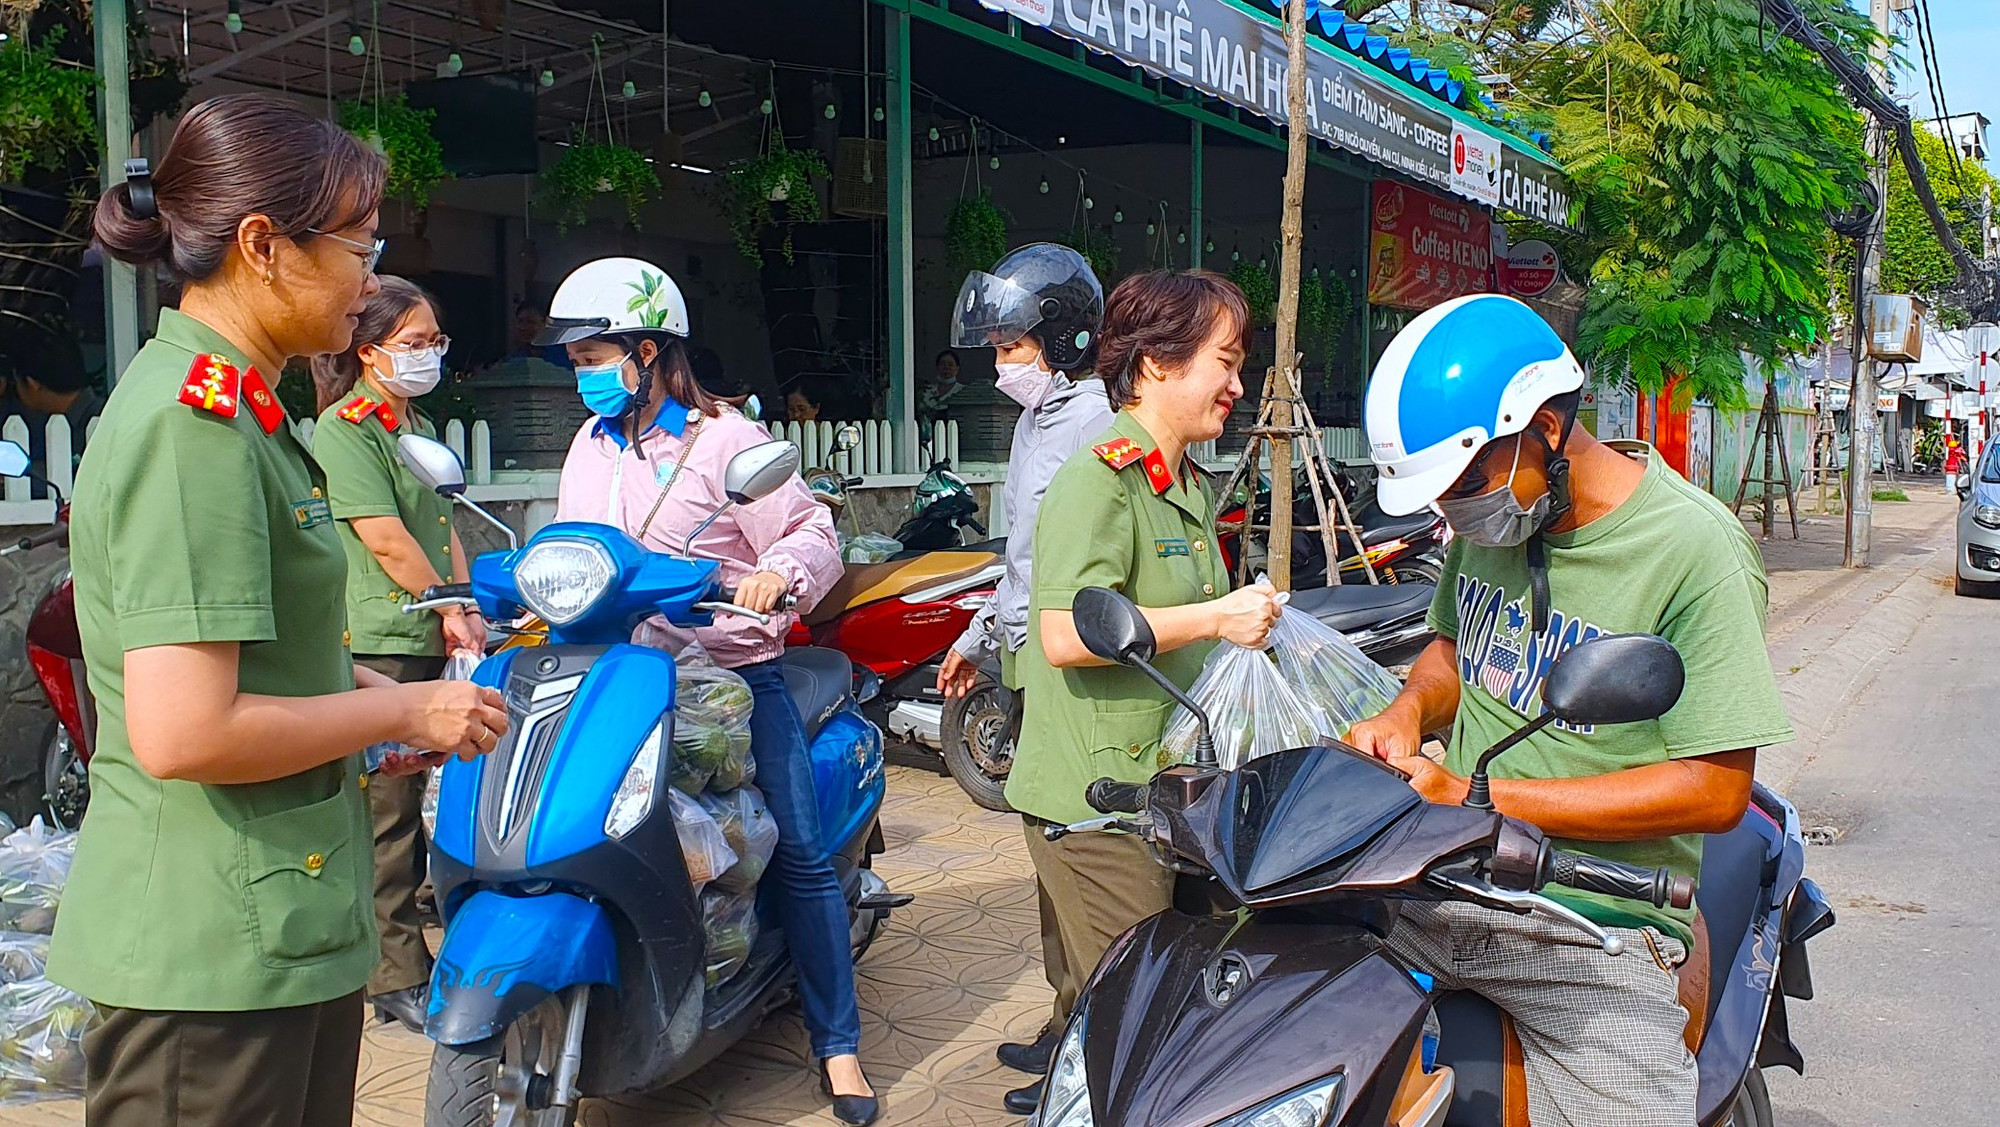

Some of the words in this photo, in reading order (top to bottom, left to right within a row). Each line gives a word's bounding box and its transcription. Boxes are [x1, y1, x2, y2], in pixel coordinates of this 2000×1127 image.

[1123, 0, 1194, 77] PHÊ
[1201, 28, 1256, 103] MAI
[1263, 56, 1319, 130] HA
[1322, 71, 1352, 113] ĐIỂM
[1354, 89, 1378, 126] TÂM
[1379, 102, 1408, 138] SÁNG
[1413, 122, 1448, 156] COFFEE
[1429, 202, 1458, 224] Vietlott
[1523, 174, 1548, 220] PHÊ
[1412, 226, 1450, 262] Coffee
[1453, 239, 1488, 271] KENO
[1494, 633, 1522, 652] USA
